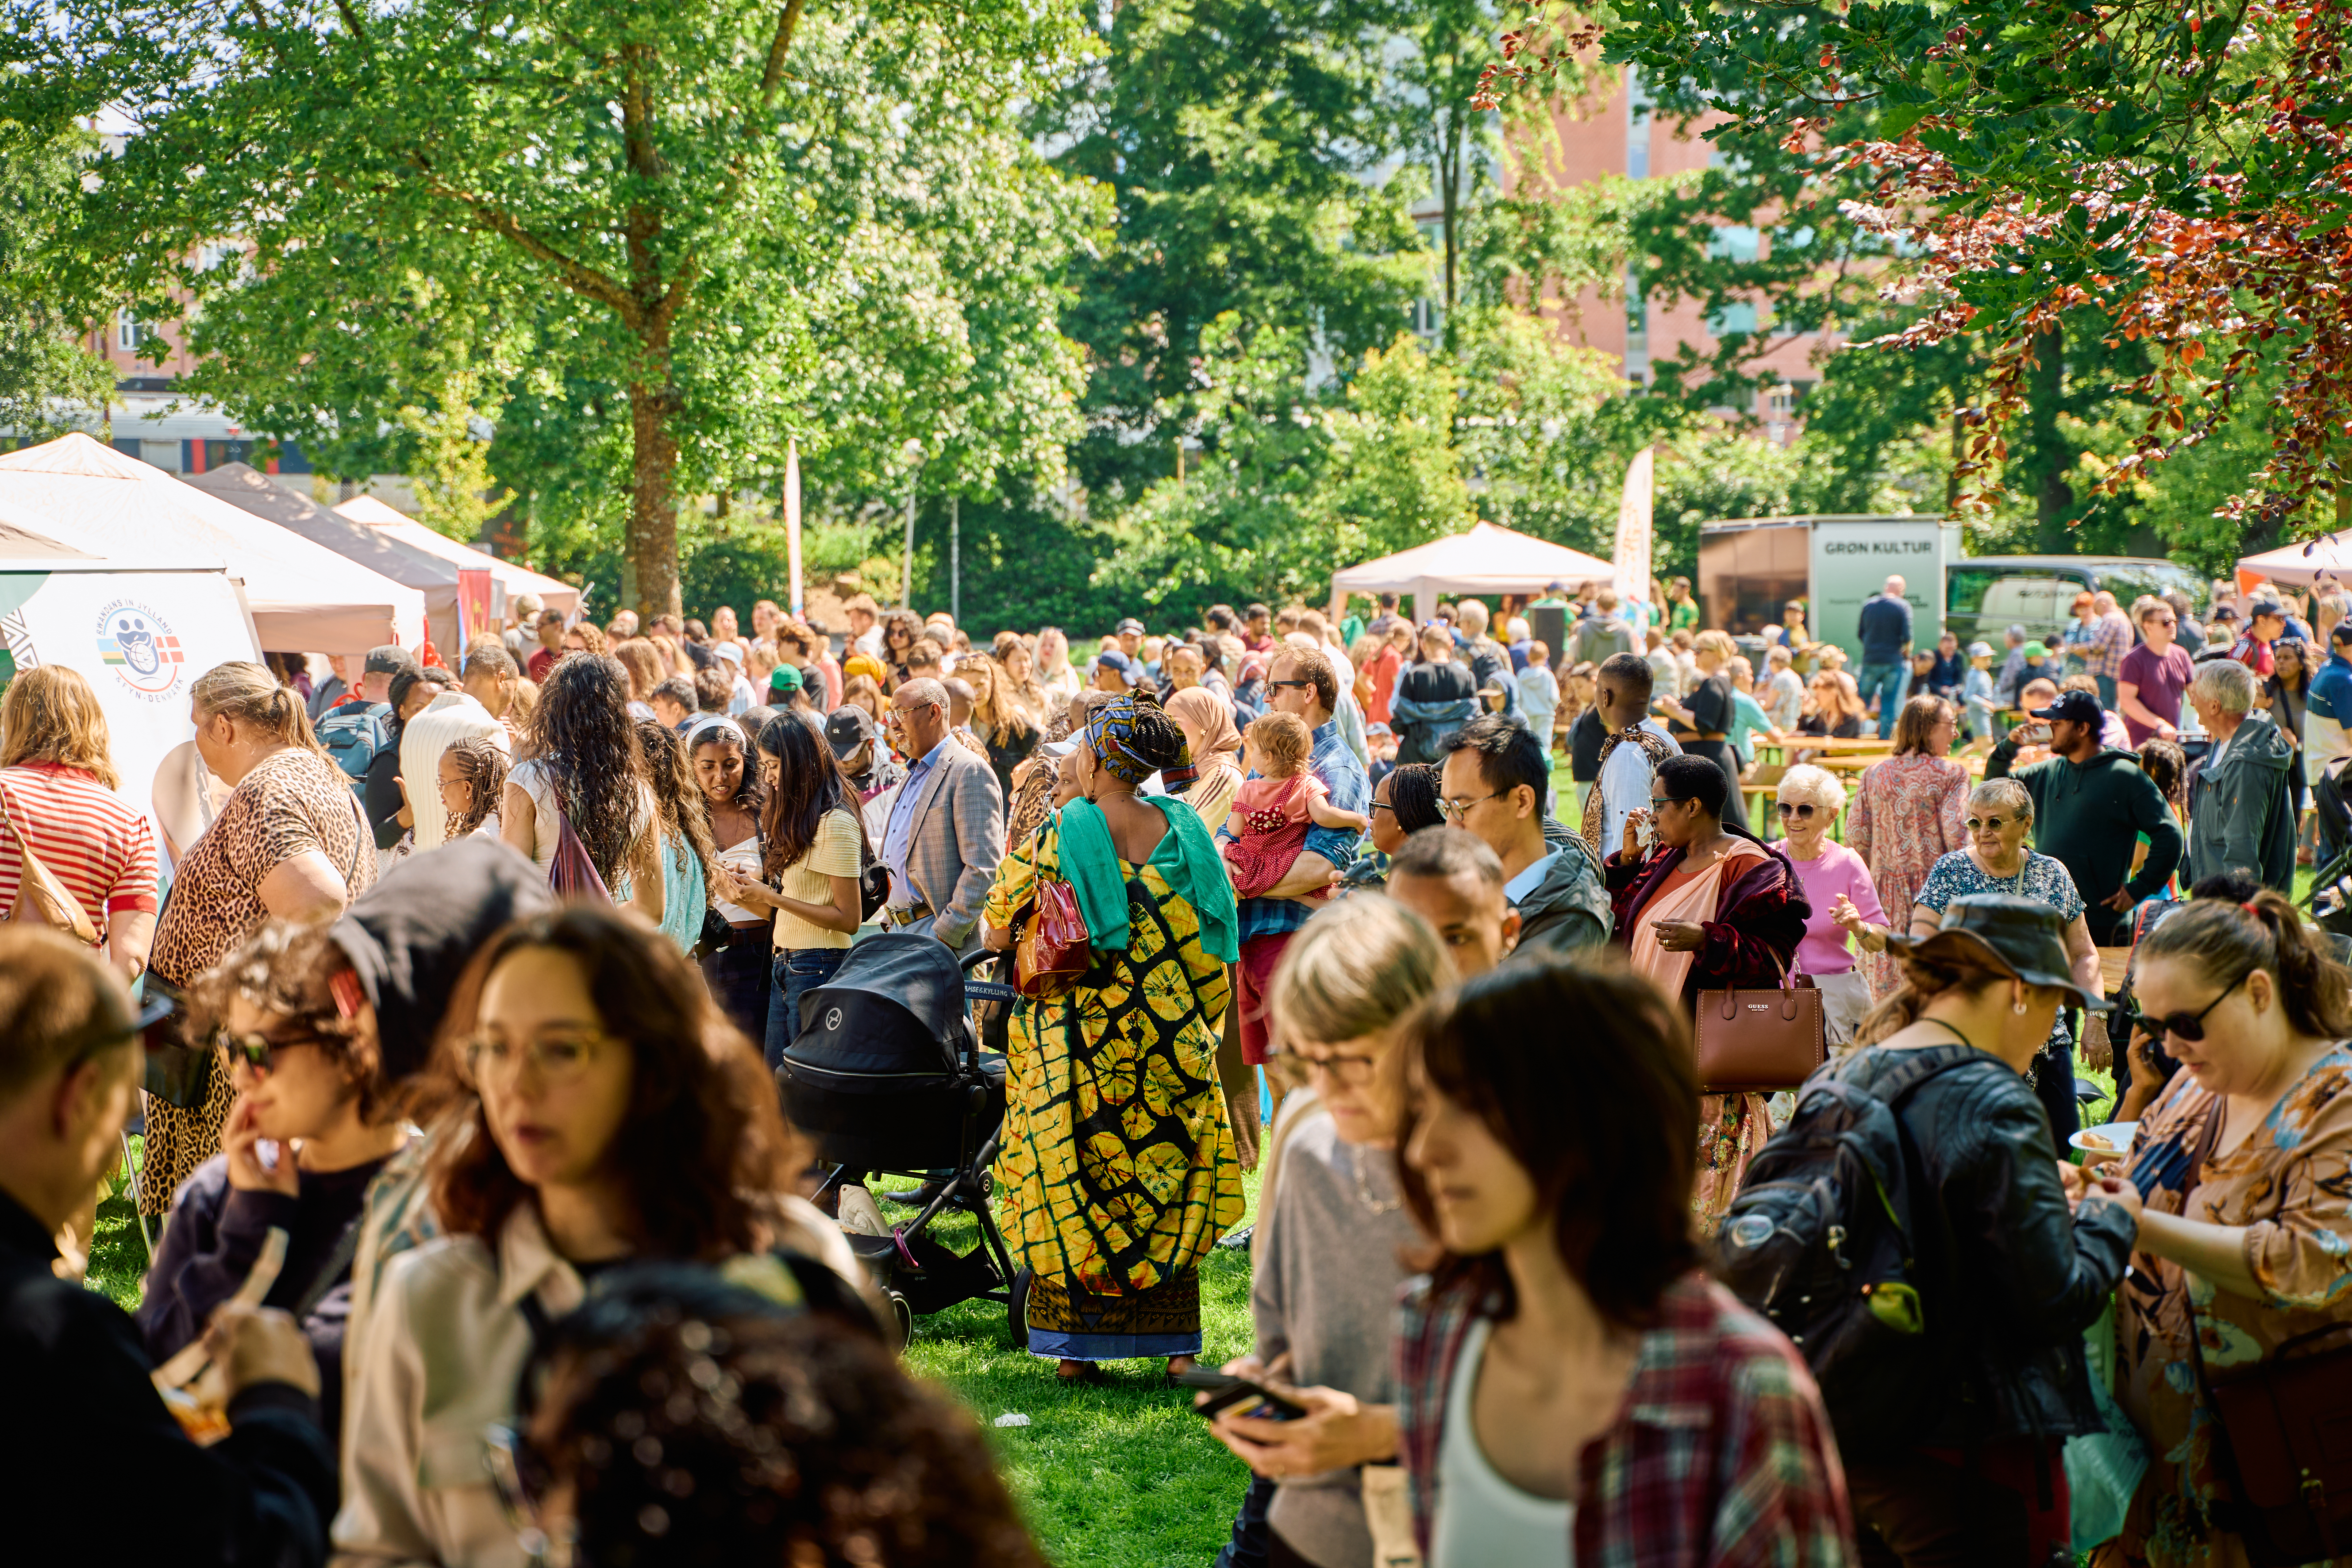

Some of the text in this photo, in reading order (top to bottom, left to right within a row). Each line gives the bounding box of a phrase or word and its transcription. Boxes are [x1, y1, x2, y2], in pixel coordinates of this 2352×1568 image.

[1825, 542, 1932, 554] GRØN KULTUR
[96, 599, 123, 636] RWANDANS
[138, 602, 172, 635] JYLLAND
[965, 985, 1008, 997] AMSE&KYLLING
